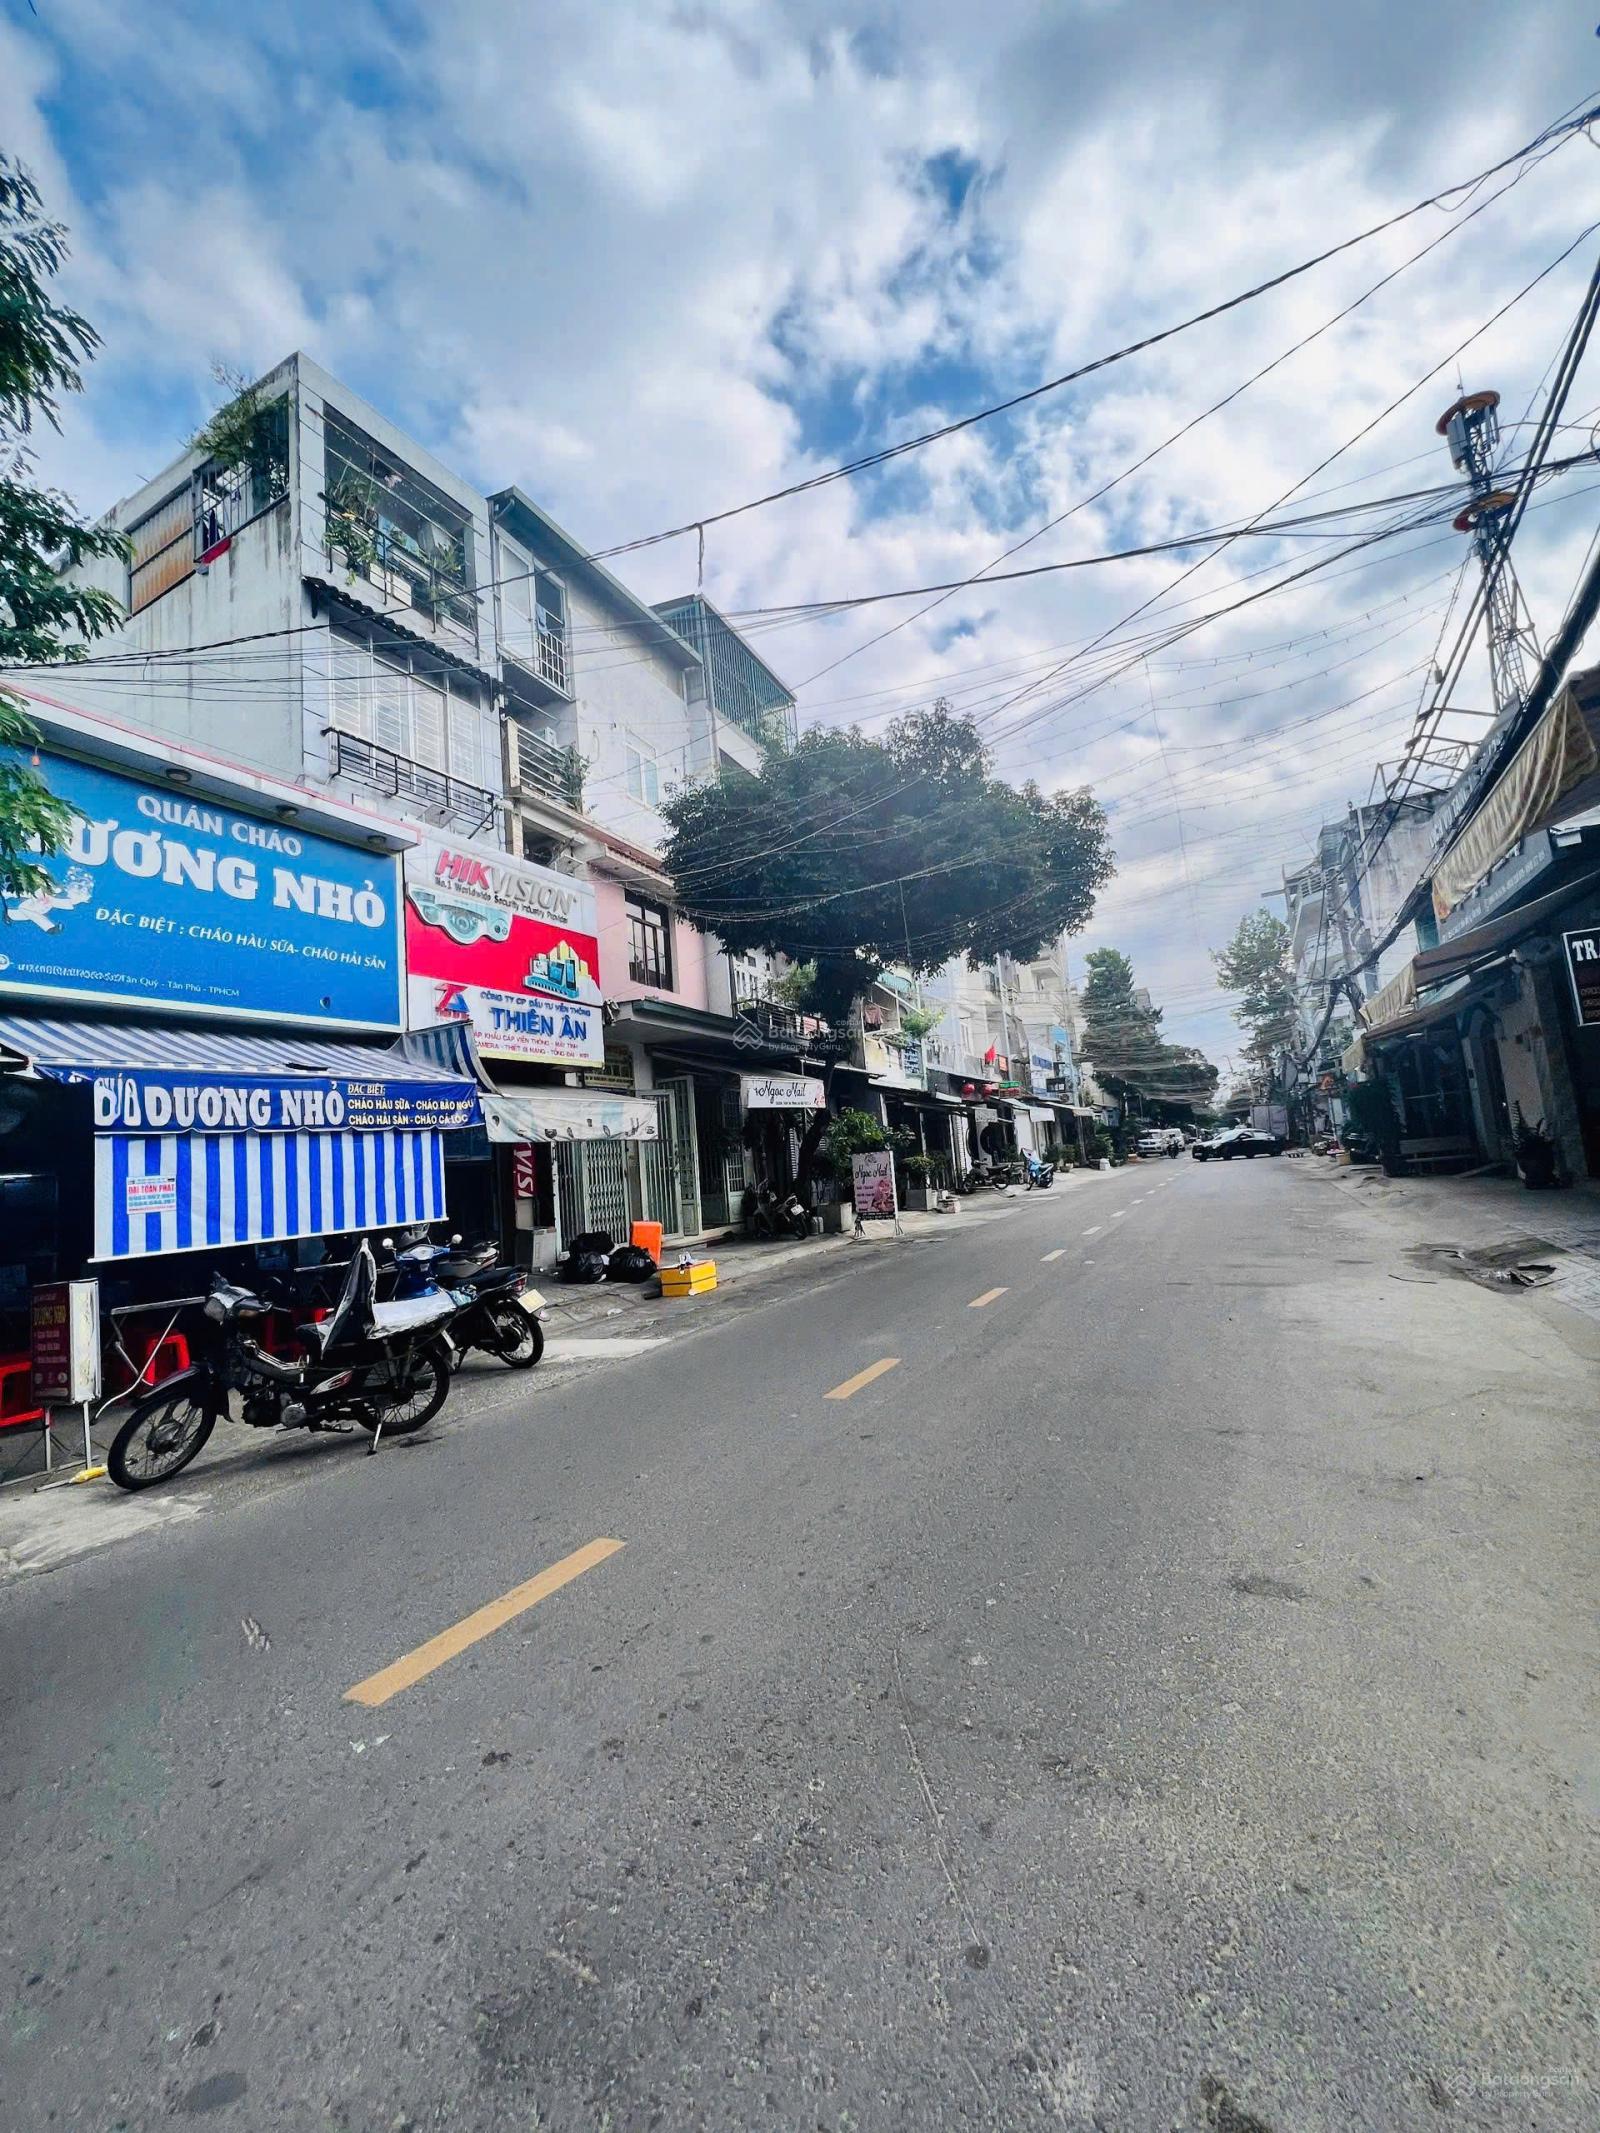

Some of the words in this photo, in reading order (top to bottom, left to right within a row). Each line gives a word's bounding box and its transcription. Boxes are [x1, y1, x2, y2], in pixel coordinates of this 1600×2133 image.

[138, 795, 224, 834] QUÁN
[232, 820, 301, 857] CHÁO
[24, 816, 258, 901] ƯƠNG
[273, 869, 385, 928] NHỎ
[435, 850, 572, 915] HIKVISION
[95, 908, 134, 927] ĐẶC
[139, 915, 177, 935] BIỆT
[188, 924, 233, 944] CHÁO
[236, 932, 267, 950] HÀU
[302, 944, 338, 962] CHÁO
[1572, 938, 1600, 962] TR
[489, 1007, 554, 1037] THIÊN
[559, 1014, 587, 1041] ÂN
[144, 1086, 271, 1127] DƯƠNG
[280, 1081, 345, 1126] NHỎ
[348, 1096, 373, 1110] CHÁO
[416, 1097, 438, 1110] CHÁO
[349, 1111, 374, 1125] CHÁO
[415, 1111, 437, 1125] CHÁO
